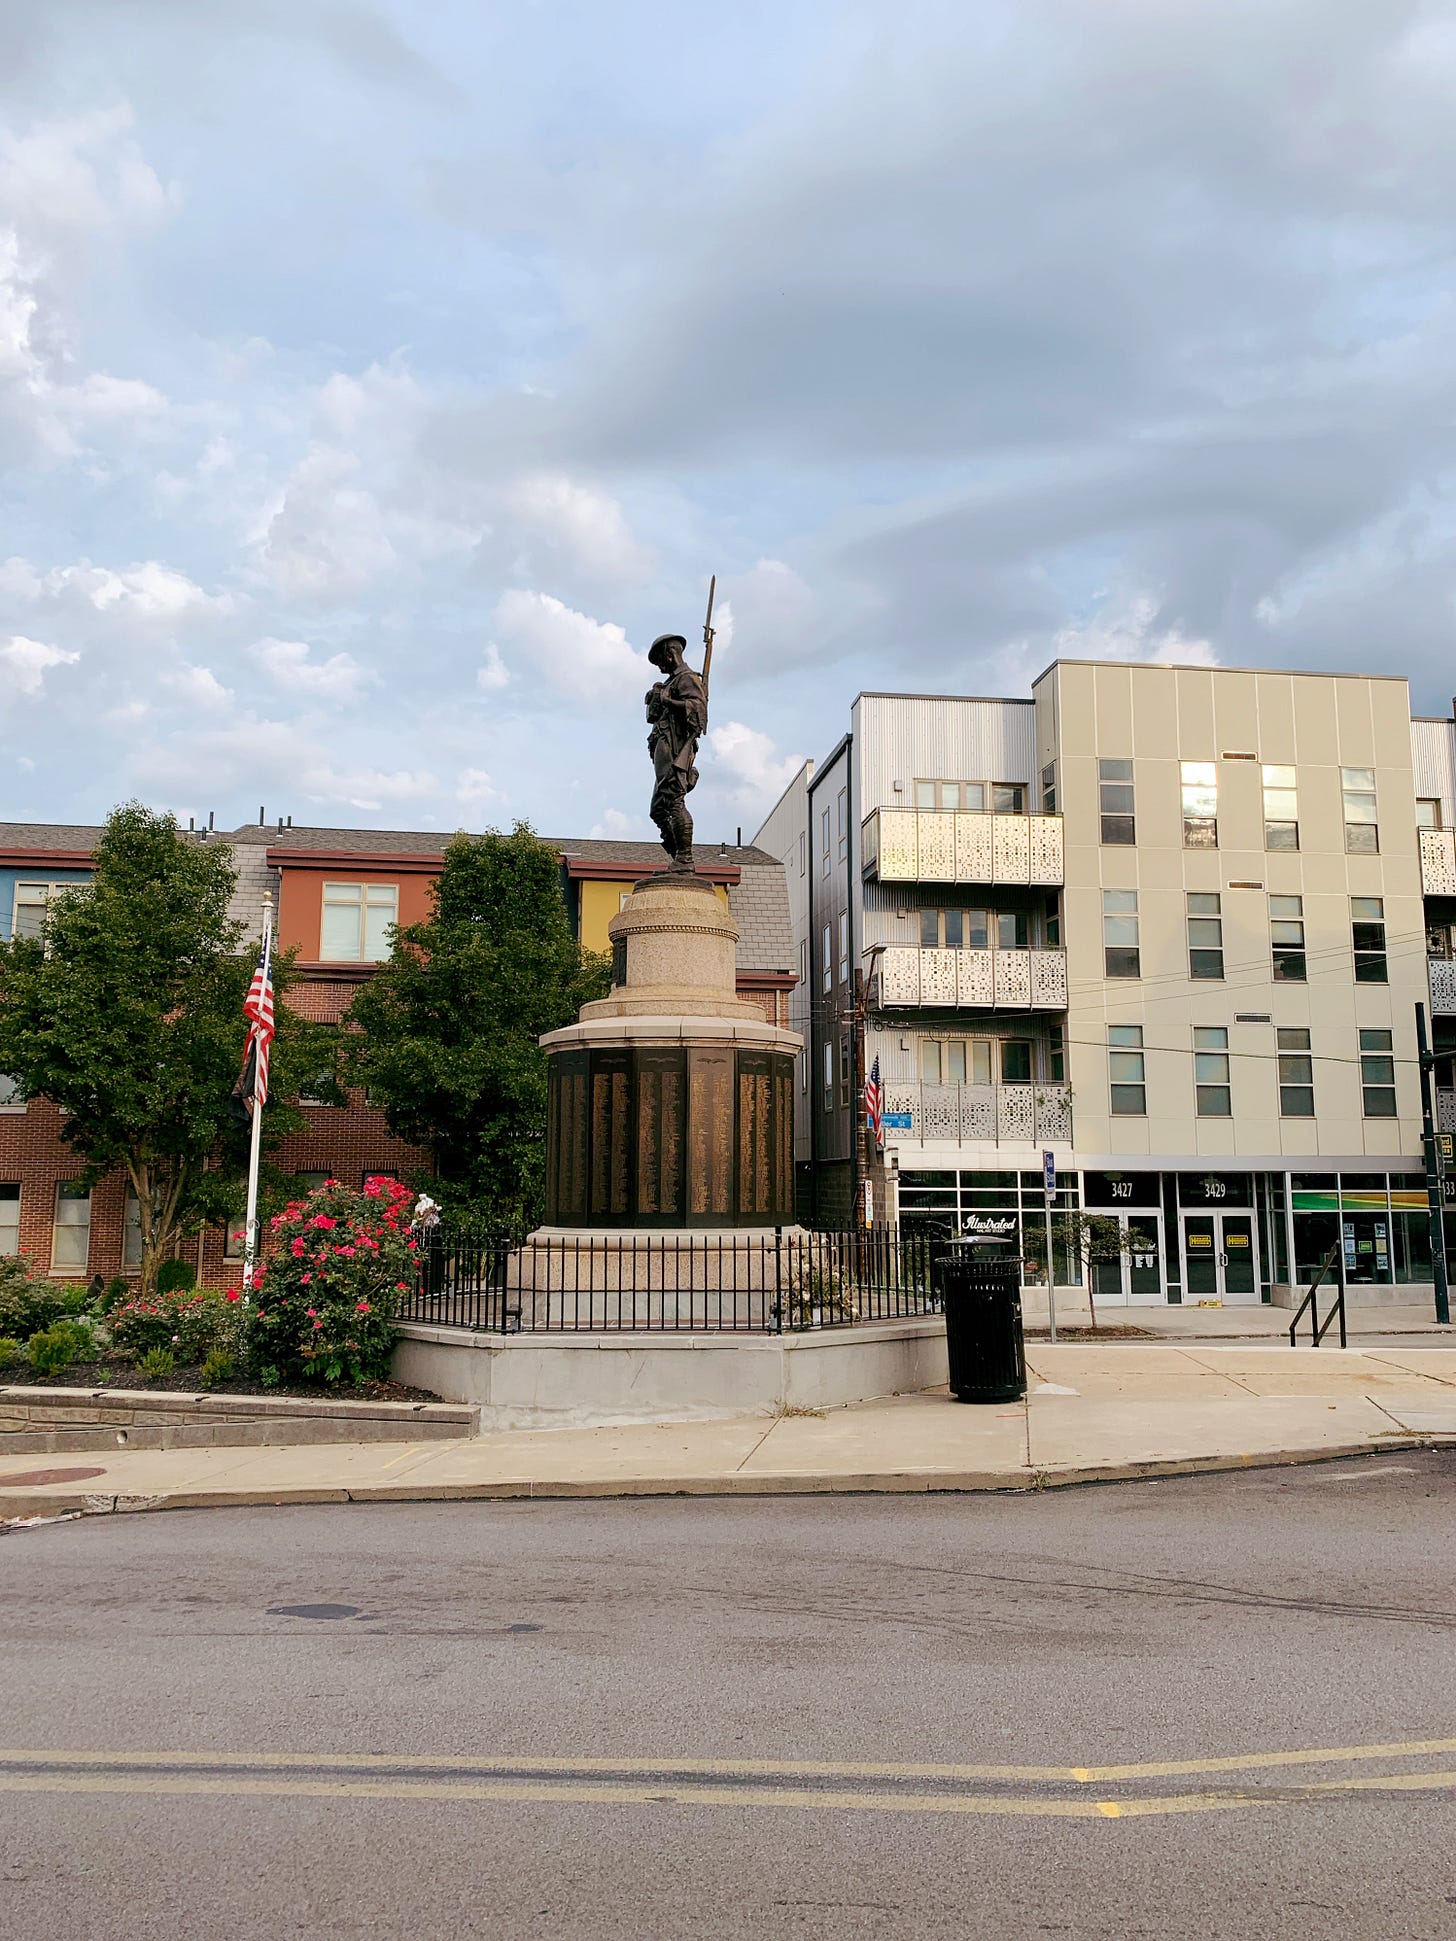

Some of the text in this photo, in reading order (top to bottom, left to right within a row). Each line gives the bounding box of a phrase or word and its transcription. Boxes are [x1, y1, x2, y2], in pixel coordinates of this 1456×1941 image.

[897, 1120, 906, 1128] St
[1112, 1182, 1133, 1197] 3427
[1205, 1183, 1226, 1198] 3429
[962, 1214, 1017, 1230] Illustrated
